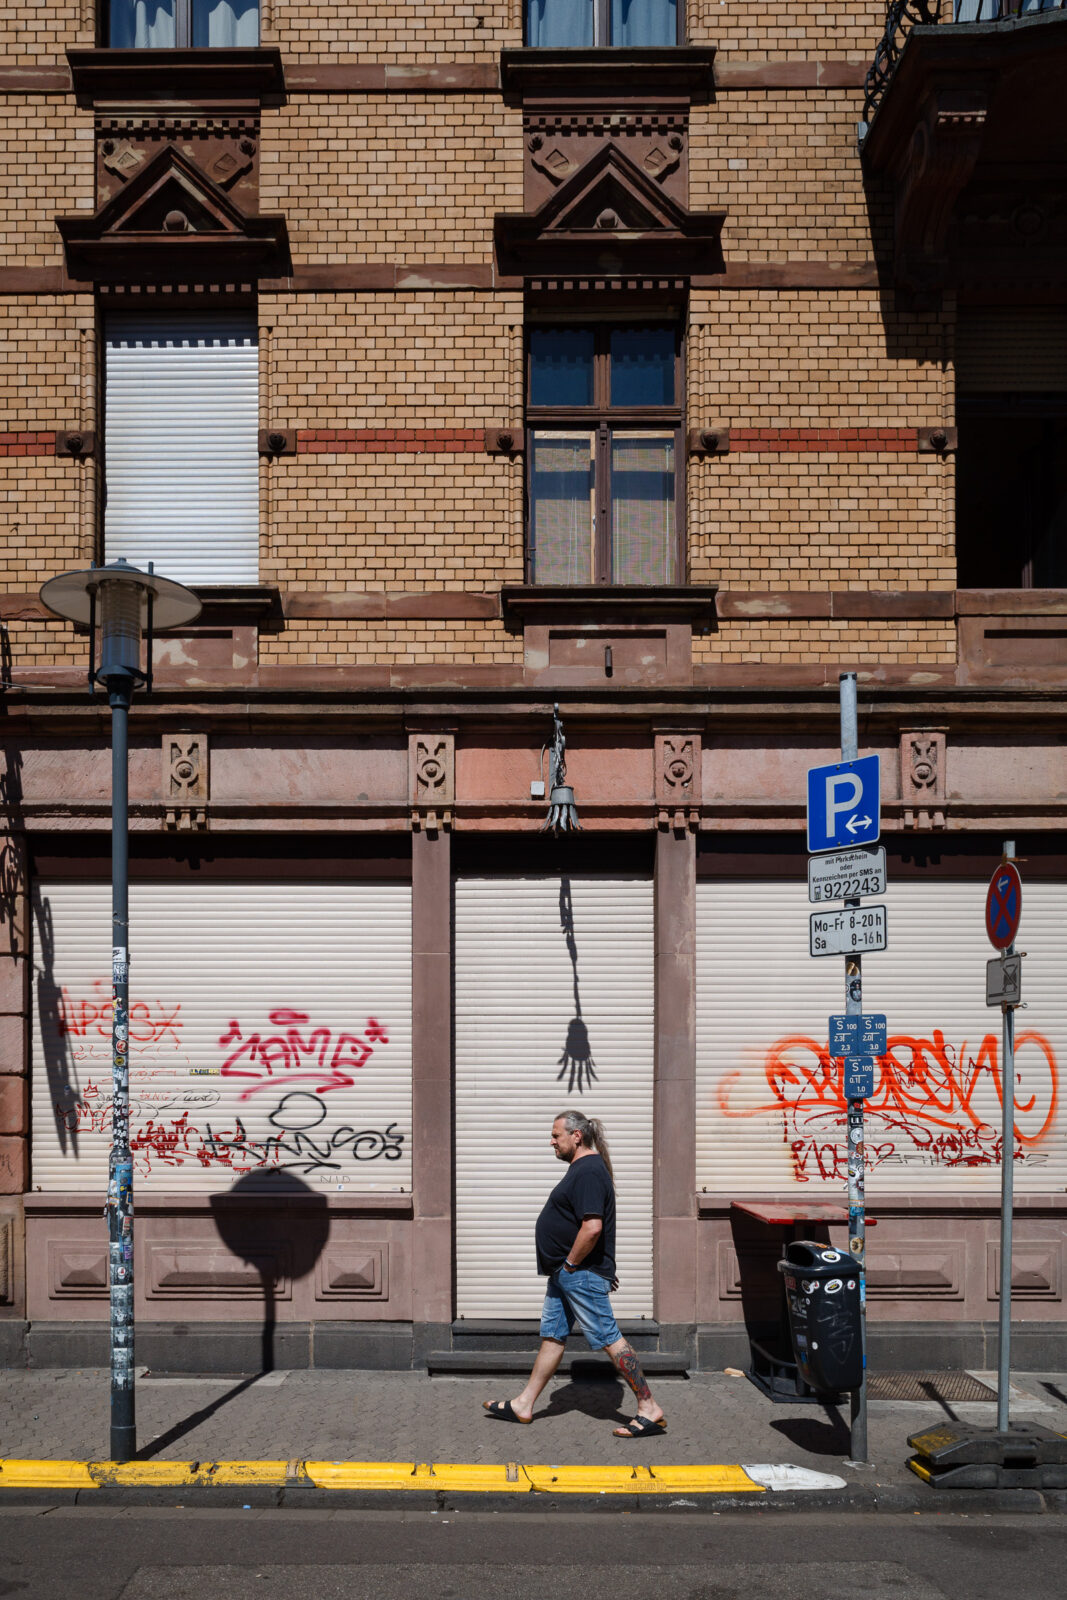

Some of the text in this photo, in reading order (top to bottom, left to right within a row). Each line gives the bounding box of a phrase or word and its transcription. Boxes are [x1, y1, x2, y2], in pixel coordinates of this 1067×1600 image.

[825, 772, 864, 838] P
[825, 853, 868, 865] mit Parkschein
[812, 872, 848, 883] Kennzeichen
[849, 870, 858, 878] per
[860, 868, 873, 877] SMS
[824, 876, 880, 899] 922243
[814, 914, 882, 933] Mo-Fr 8-20 h
[815, 931, 882, 950] Sa 8-16 h
[836, 1020, 844, 1030] S
[865, 1020, 872, 1030] S
[852, 1062, 859, 1072] S
